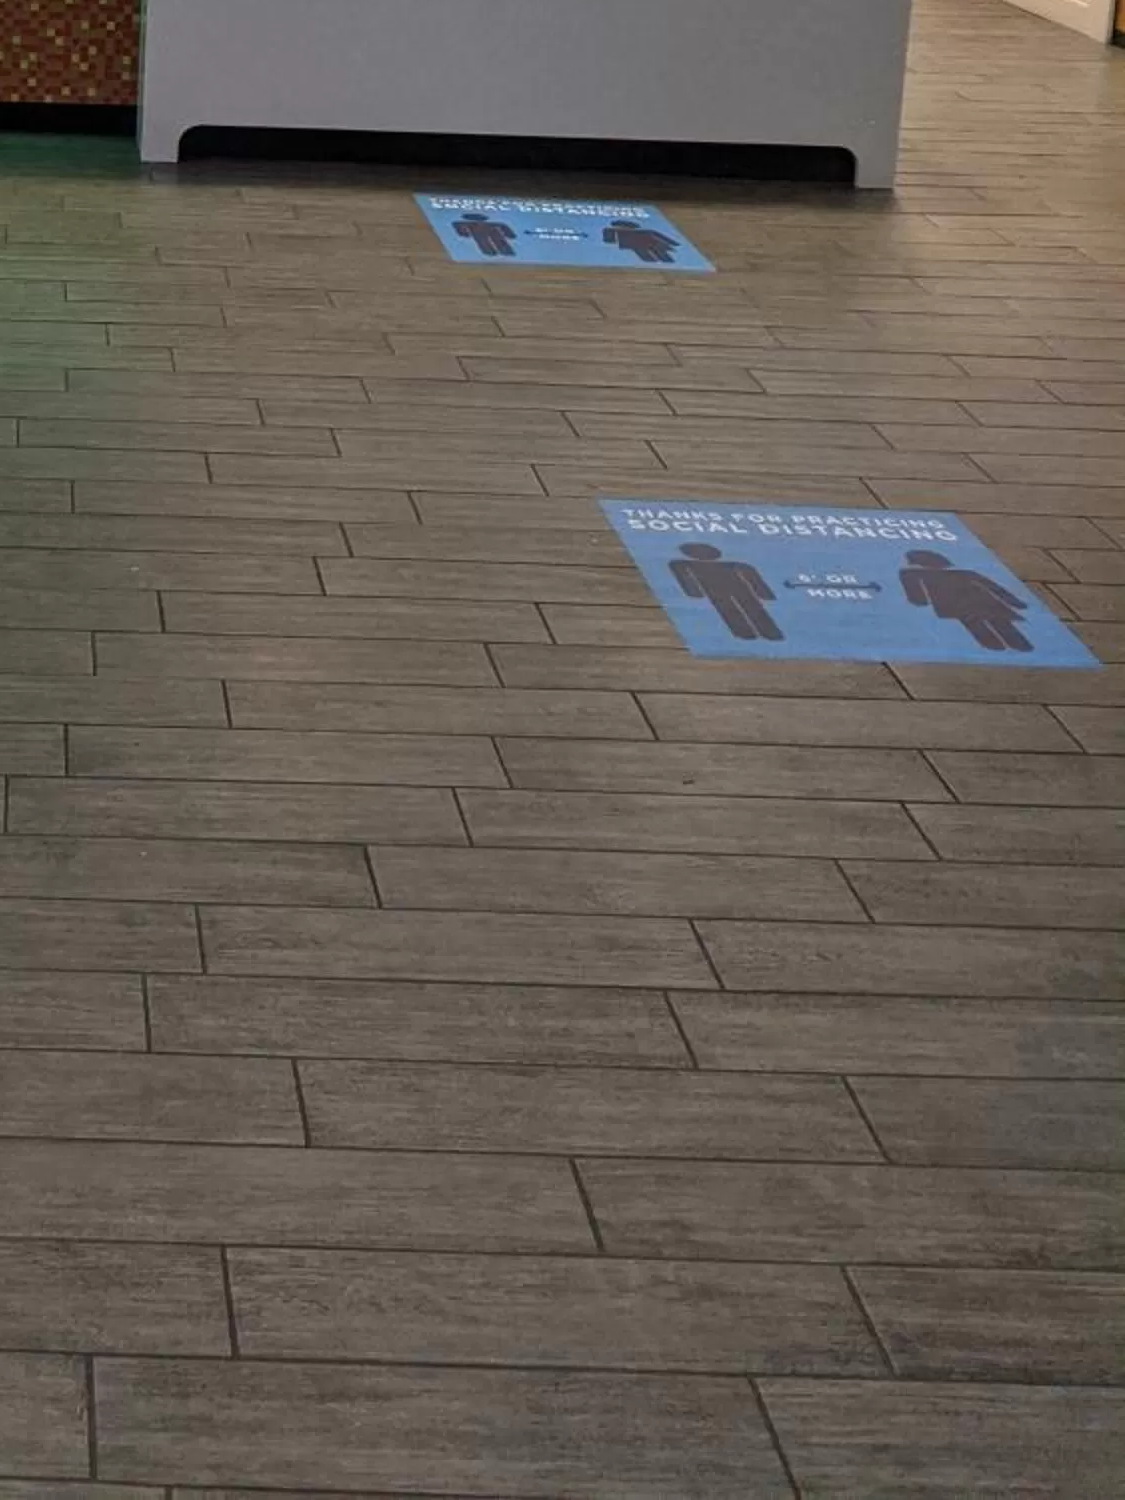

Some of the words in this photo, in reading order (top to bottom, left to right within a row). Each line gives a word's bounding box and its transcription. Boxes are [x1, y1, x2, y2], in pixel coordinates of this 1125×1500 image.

[622, 508, 724, 521] THANKS
[730, 513, 783, 524] FOR
[790, 514, 945, 530] PRACTICING
[627, 519, 748, 534] SOCIAL
[758, 523, 958, 542] DISTANCING
[806, 588, 873, 600] MORE
